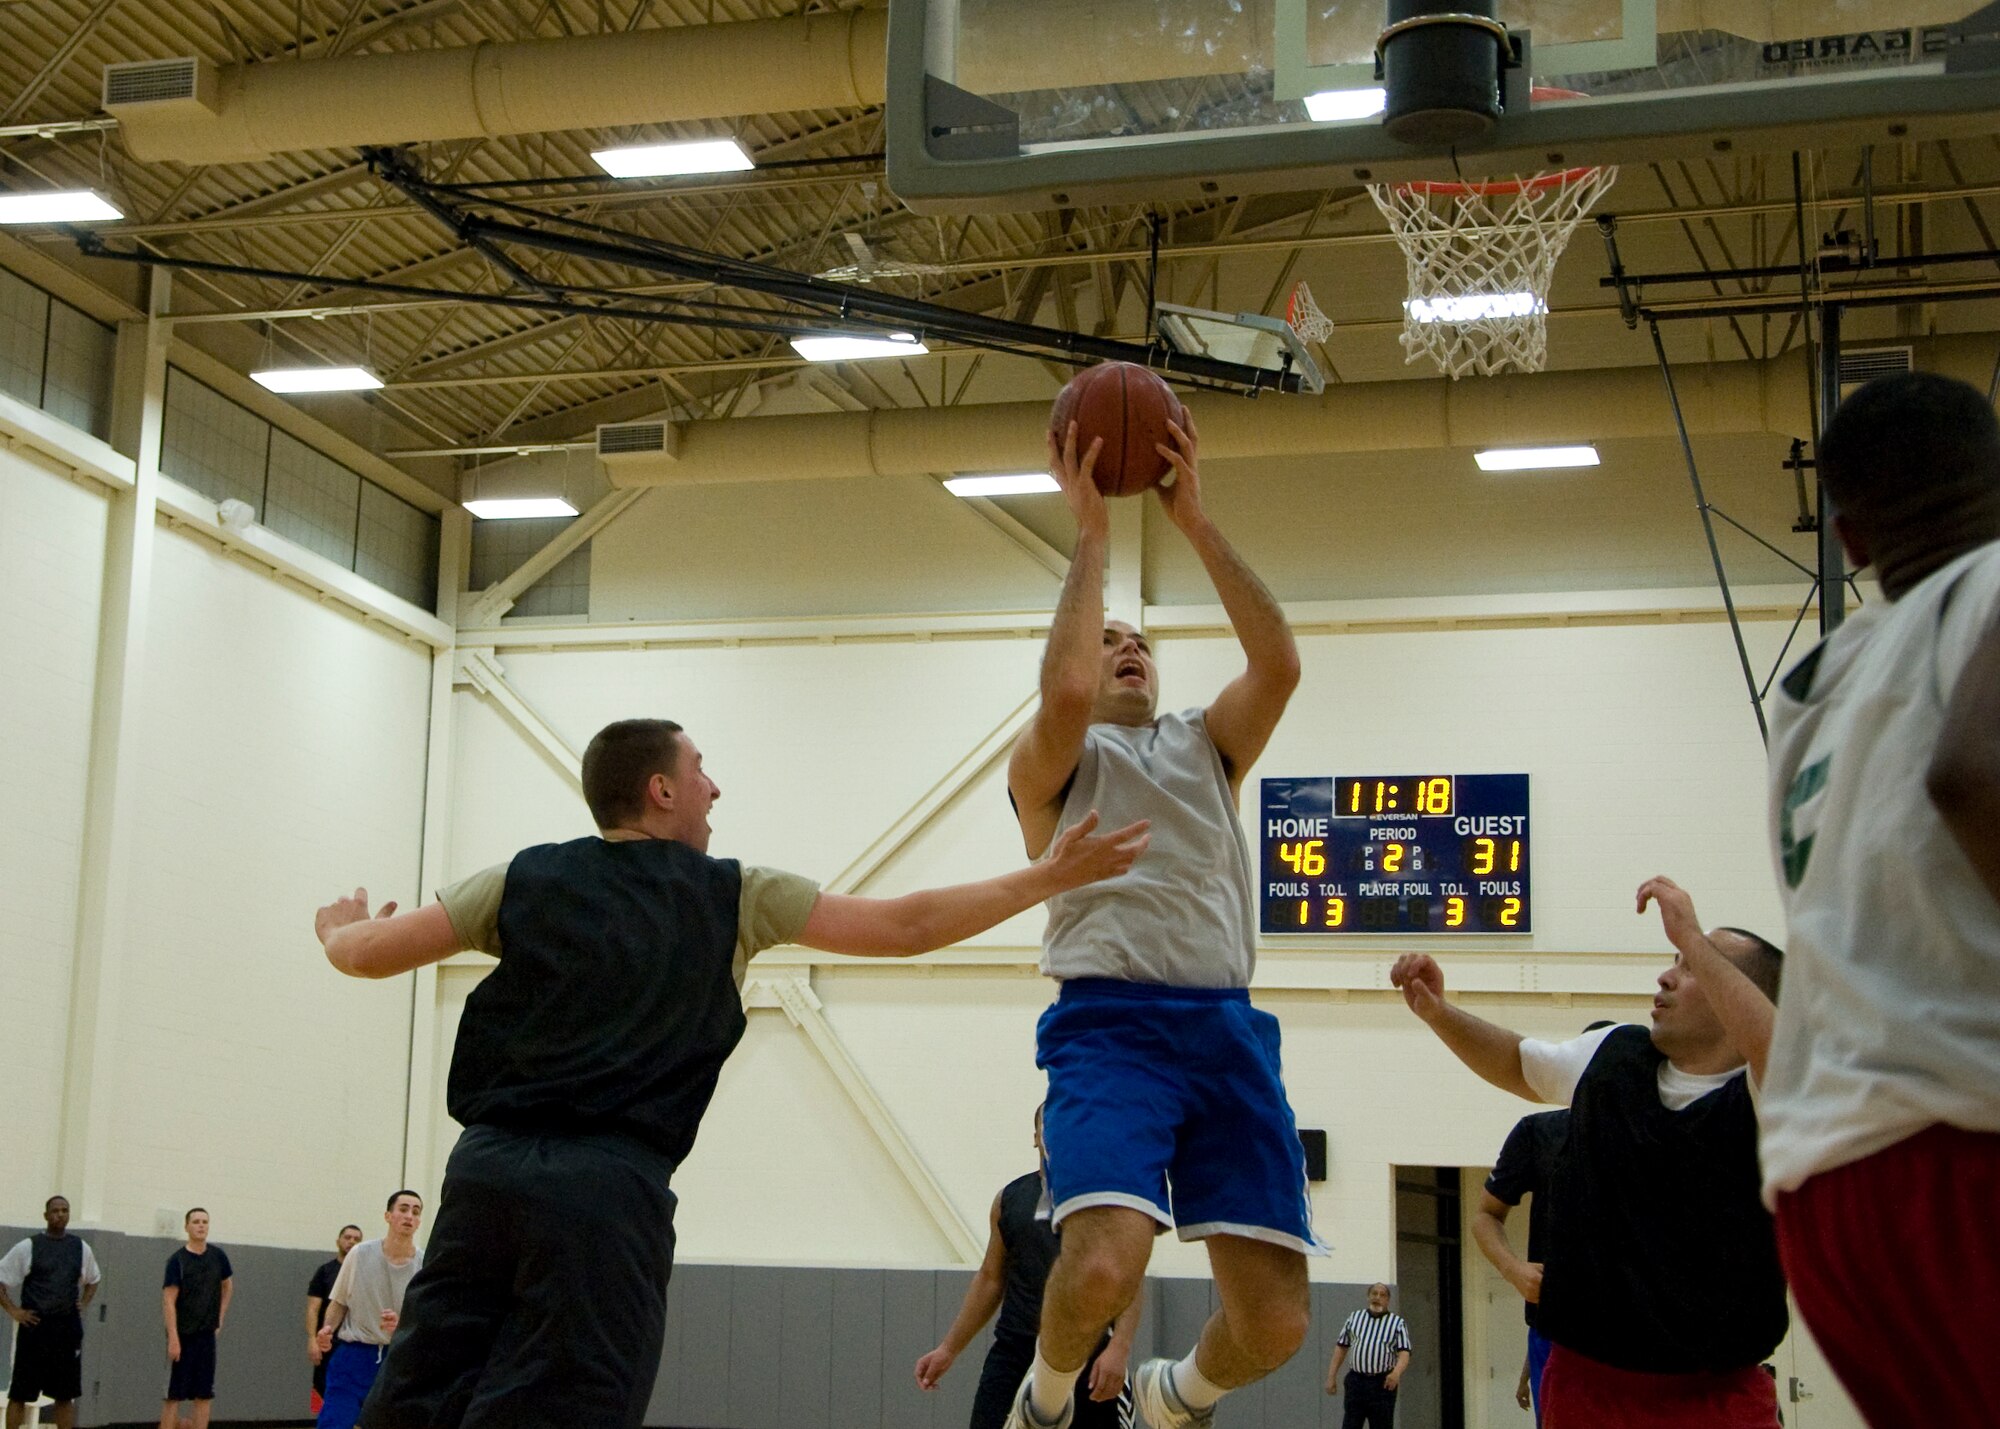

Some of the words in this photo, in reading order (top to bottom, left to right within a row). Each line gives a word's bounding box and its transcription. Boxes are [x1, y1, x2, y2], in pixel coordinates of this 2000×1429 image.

[1351, 778, 1450, 814] 11:18
[1376, 813, 1418, 821] EVERSAN
[1269, 819, 1328, 838] HOME
[1455, 816, 1525, 836] GUEST
[1370, 828, 1416, 840] PERIOD
[1365, 847, 1373, 856] P
[1413, 846, 1421, 856] P
[1473, 839, 1520, 874] 31
[1280, 841, 1325, 875] 46
[1383, 844, 1403, 872] 2
[1365, 861, 1374, 870] B
[1413, 860, 1422, 870] B
[1269, 883, 1309, 896] FOULS
[1319, 884, 1347, 896] T.O.L.
[1360, 884, 1399, 896] PLAYER
[1404, 883, 1432, 895] FOUL
[1441, 884, 1468, 895] T.O.L.
[1480, 882, 1520, 895] FOULS
[1326, 899, 1344, 926] 3
[1446, 898, 1464, 926] 3
[1501, 898, 1520, 926] 2
